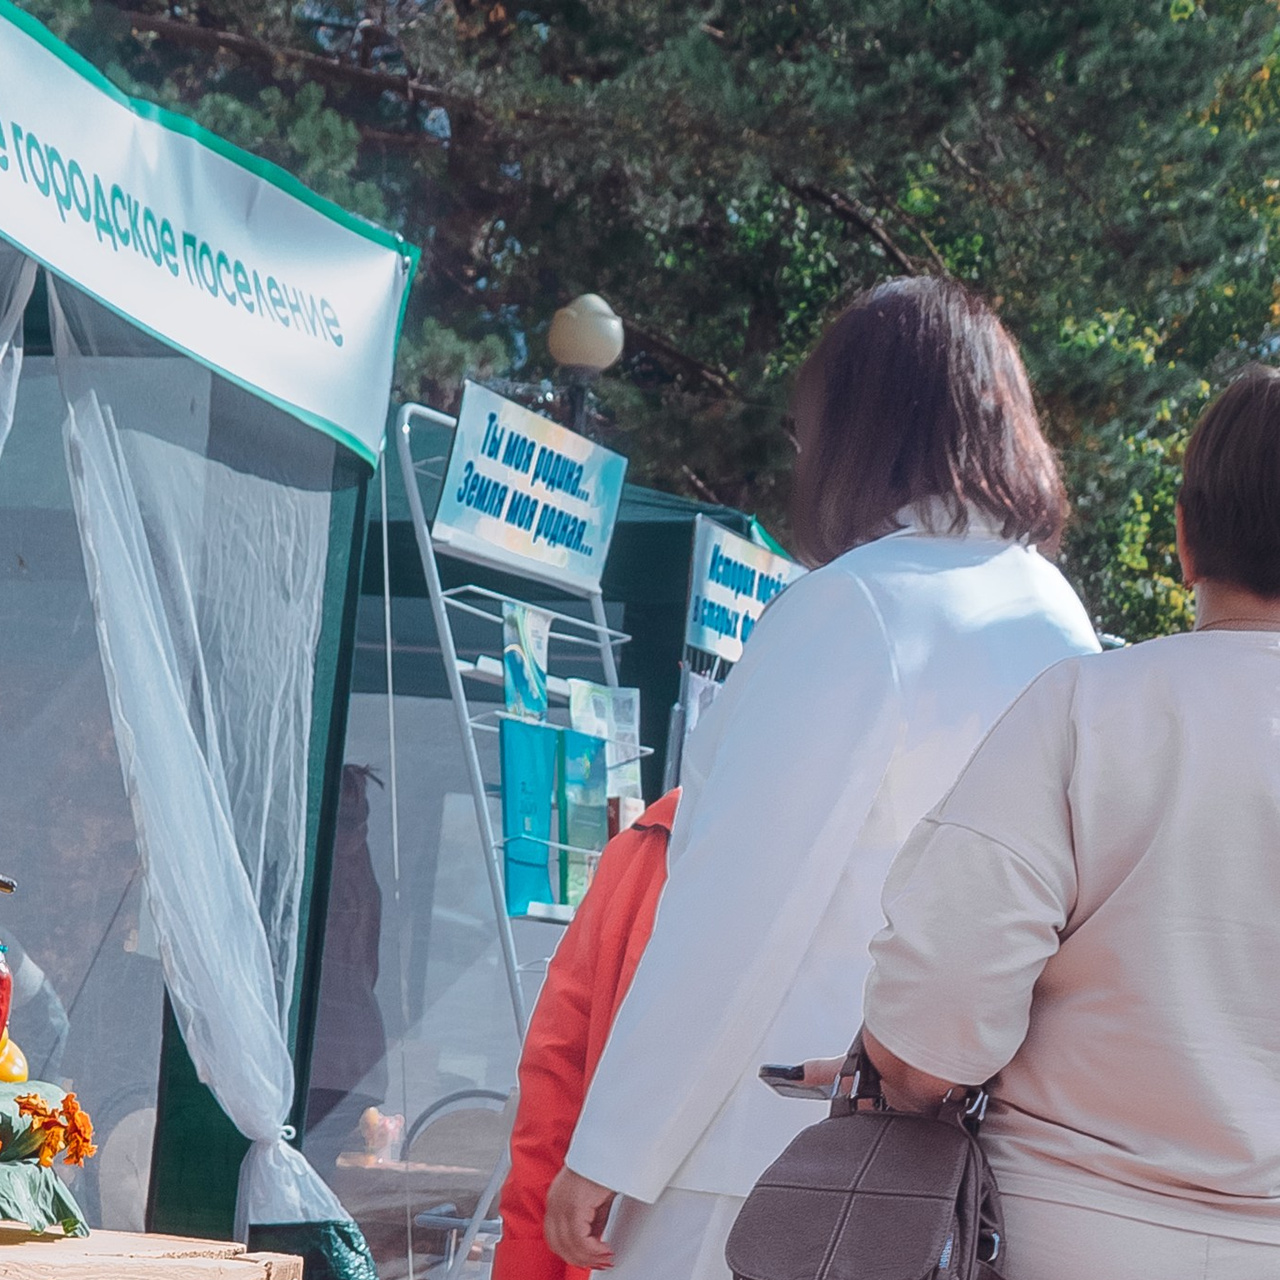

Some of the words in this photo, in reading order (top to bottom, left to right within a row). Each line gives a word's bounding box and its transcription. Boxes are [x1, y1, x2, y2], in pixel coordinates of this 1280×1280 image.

[10, 120, 179, 278] городское
[182, 231, 343, 347] поселение
[480, 412, 506, 461] Ты
[501, 430, 536, 475] моя
[531, 446, 590, 502] родина...
[456, 460, 509, 519] Земля
[504, 490, 539, 532] моя
[532, 503, 593, 557] родная...
[708, 543, 757, 600] История
